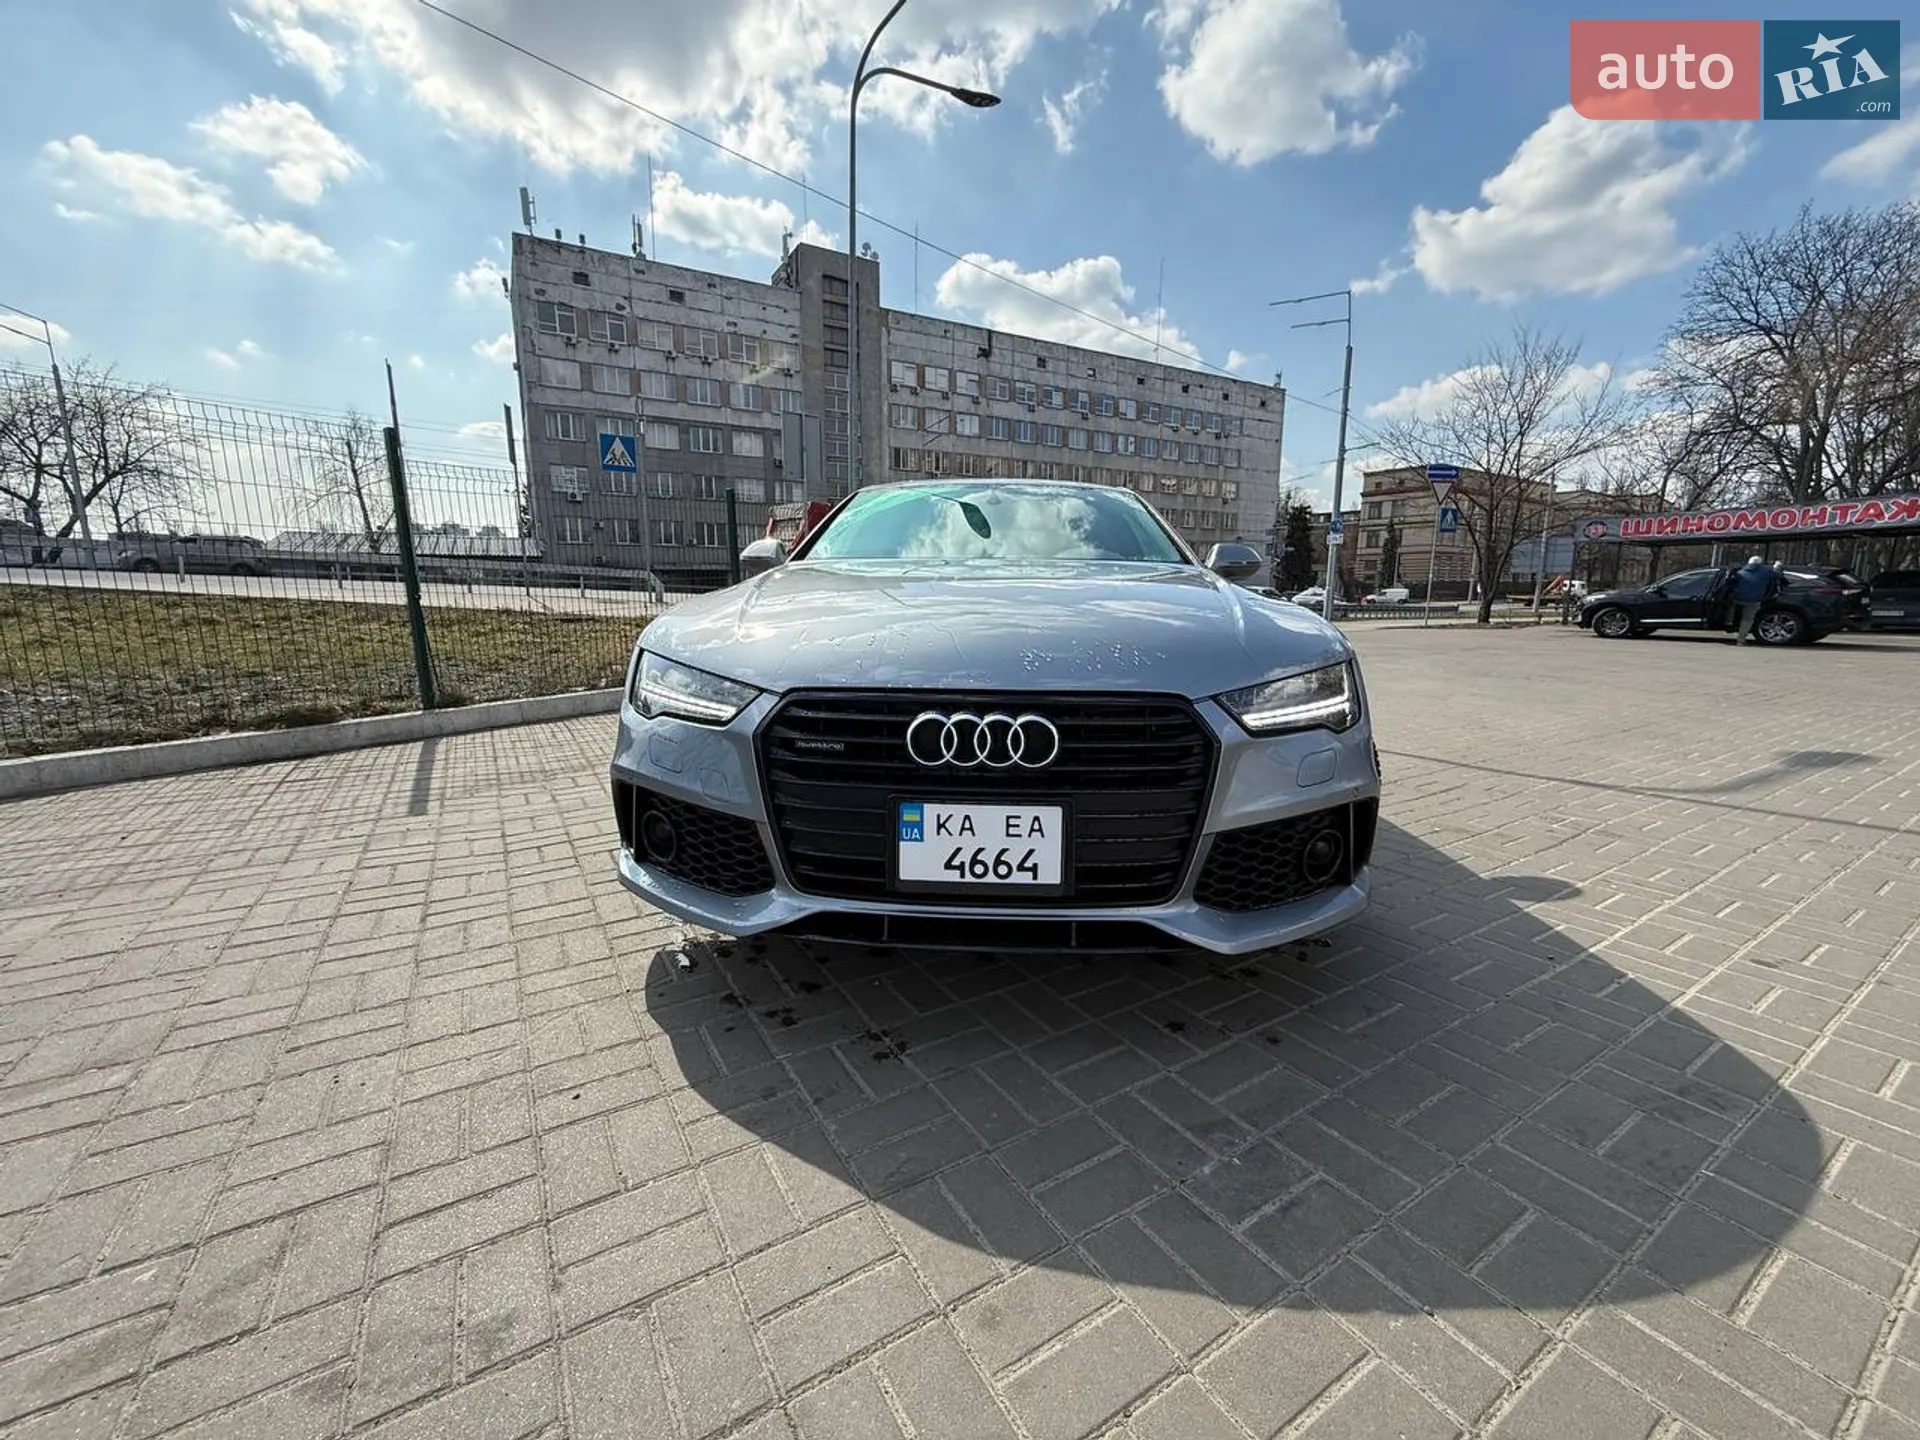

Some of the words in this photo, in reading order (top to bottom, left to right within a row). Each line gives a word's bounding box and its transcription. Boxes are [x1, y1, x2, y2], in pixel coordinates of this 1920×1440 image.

[902, 828, 921, 840] UA
[936, 813, 975, 837] KA
[1005, 815, 1045, 838] EA
[943, 846, 1039, 881] 4664
